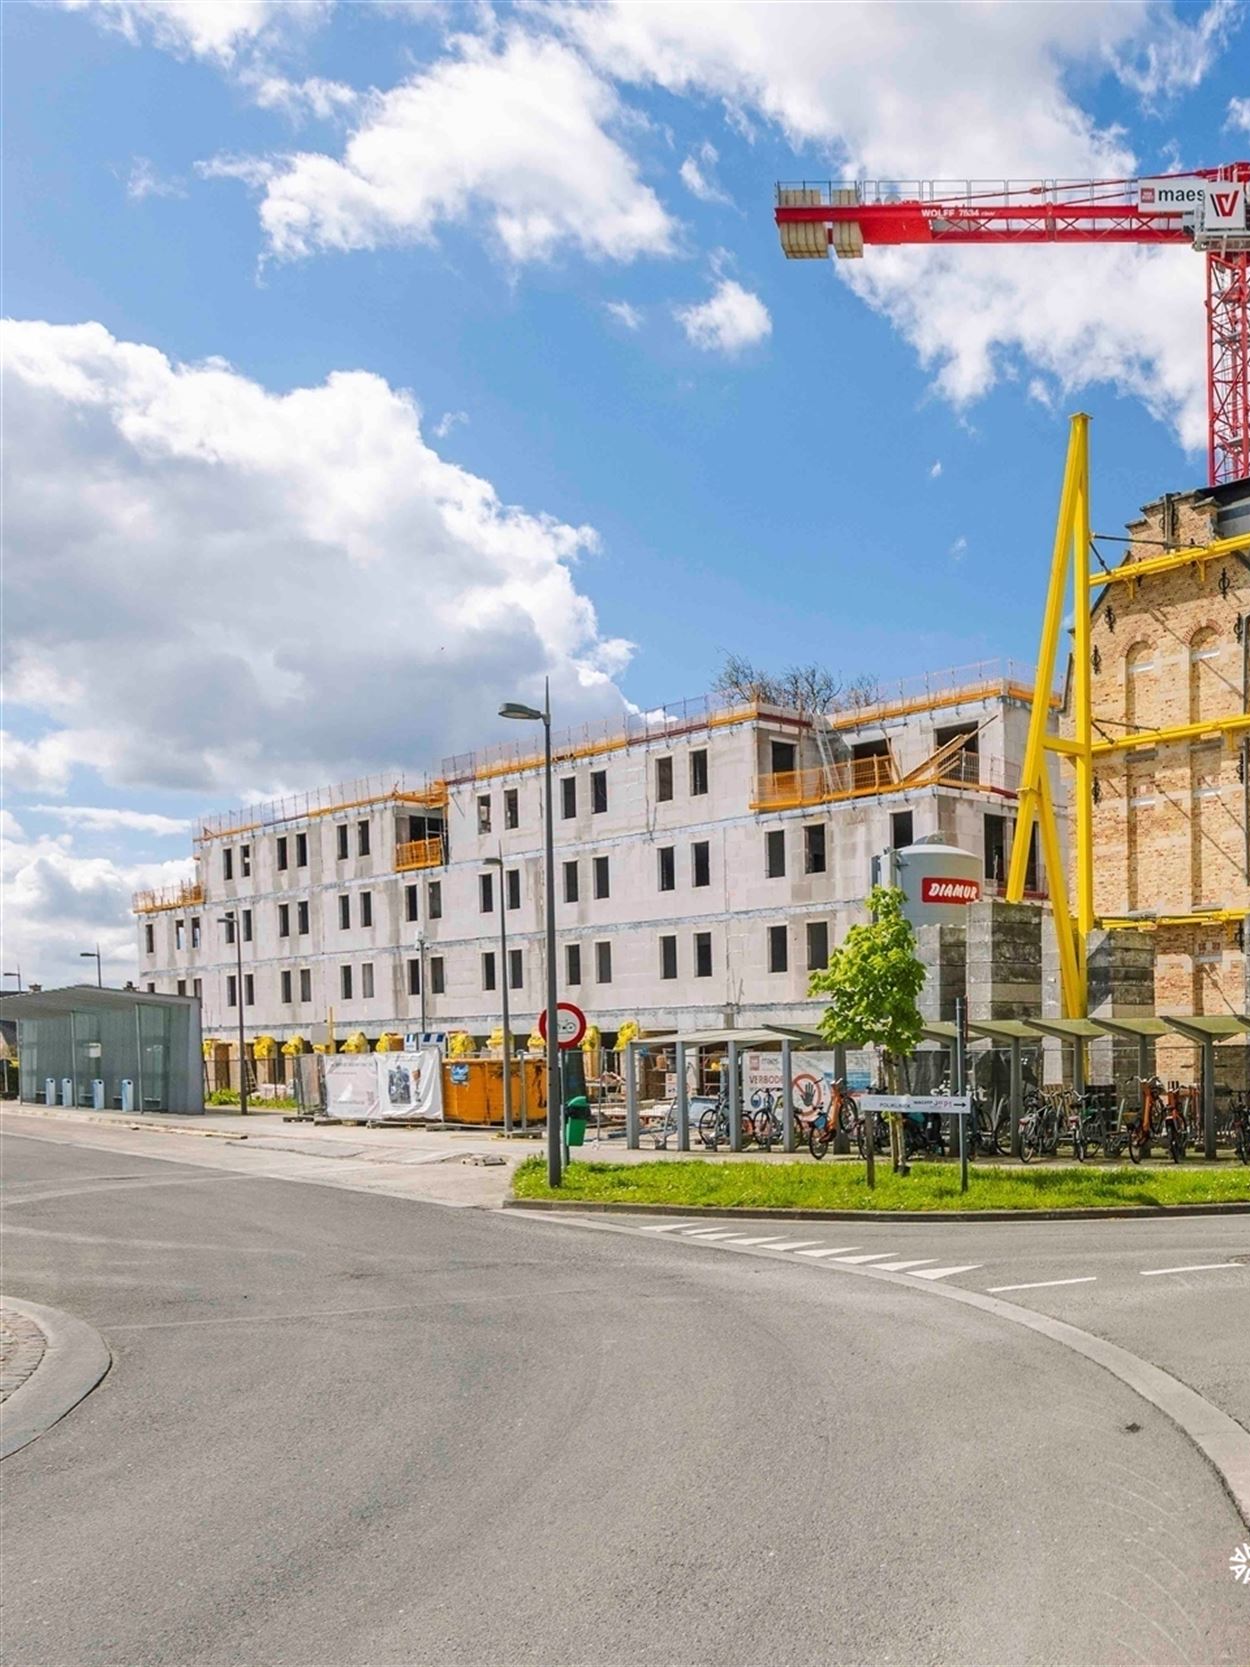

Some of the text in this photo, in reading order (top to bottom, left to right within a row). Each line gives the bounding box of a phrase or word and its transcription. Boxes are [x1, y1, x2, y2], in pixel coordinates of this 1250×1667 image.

[1158, 189, 1205, 202] maes
[921, 209, 955, 217] WOLFF
[928, 883, 978, 900] DIAMUR
